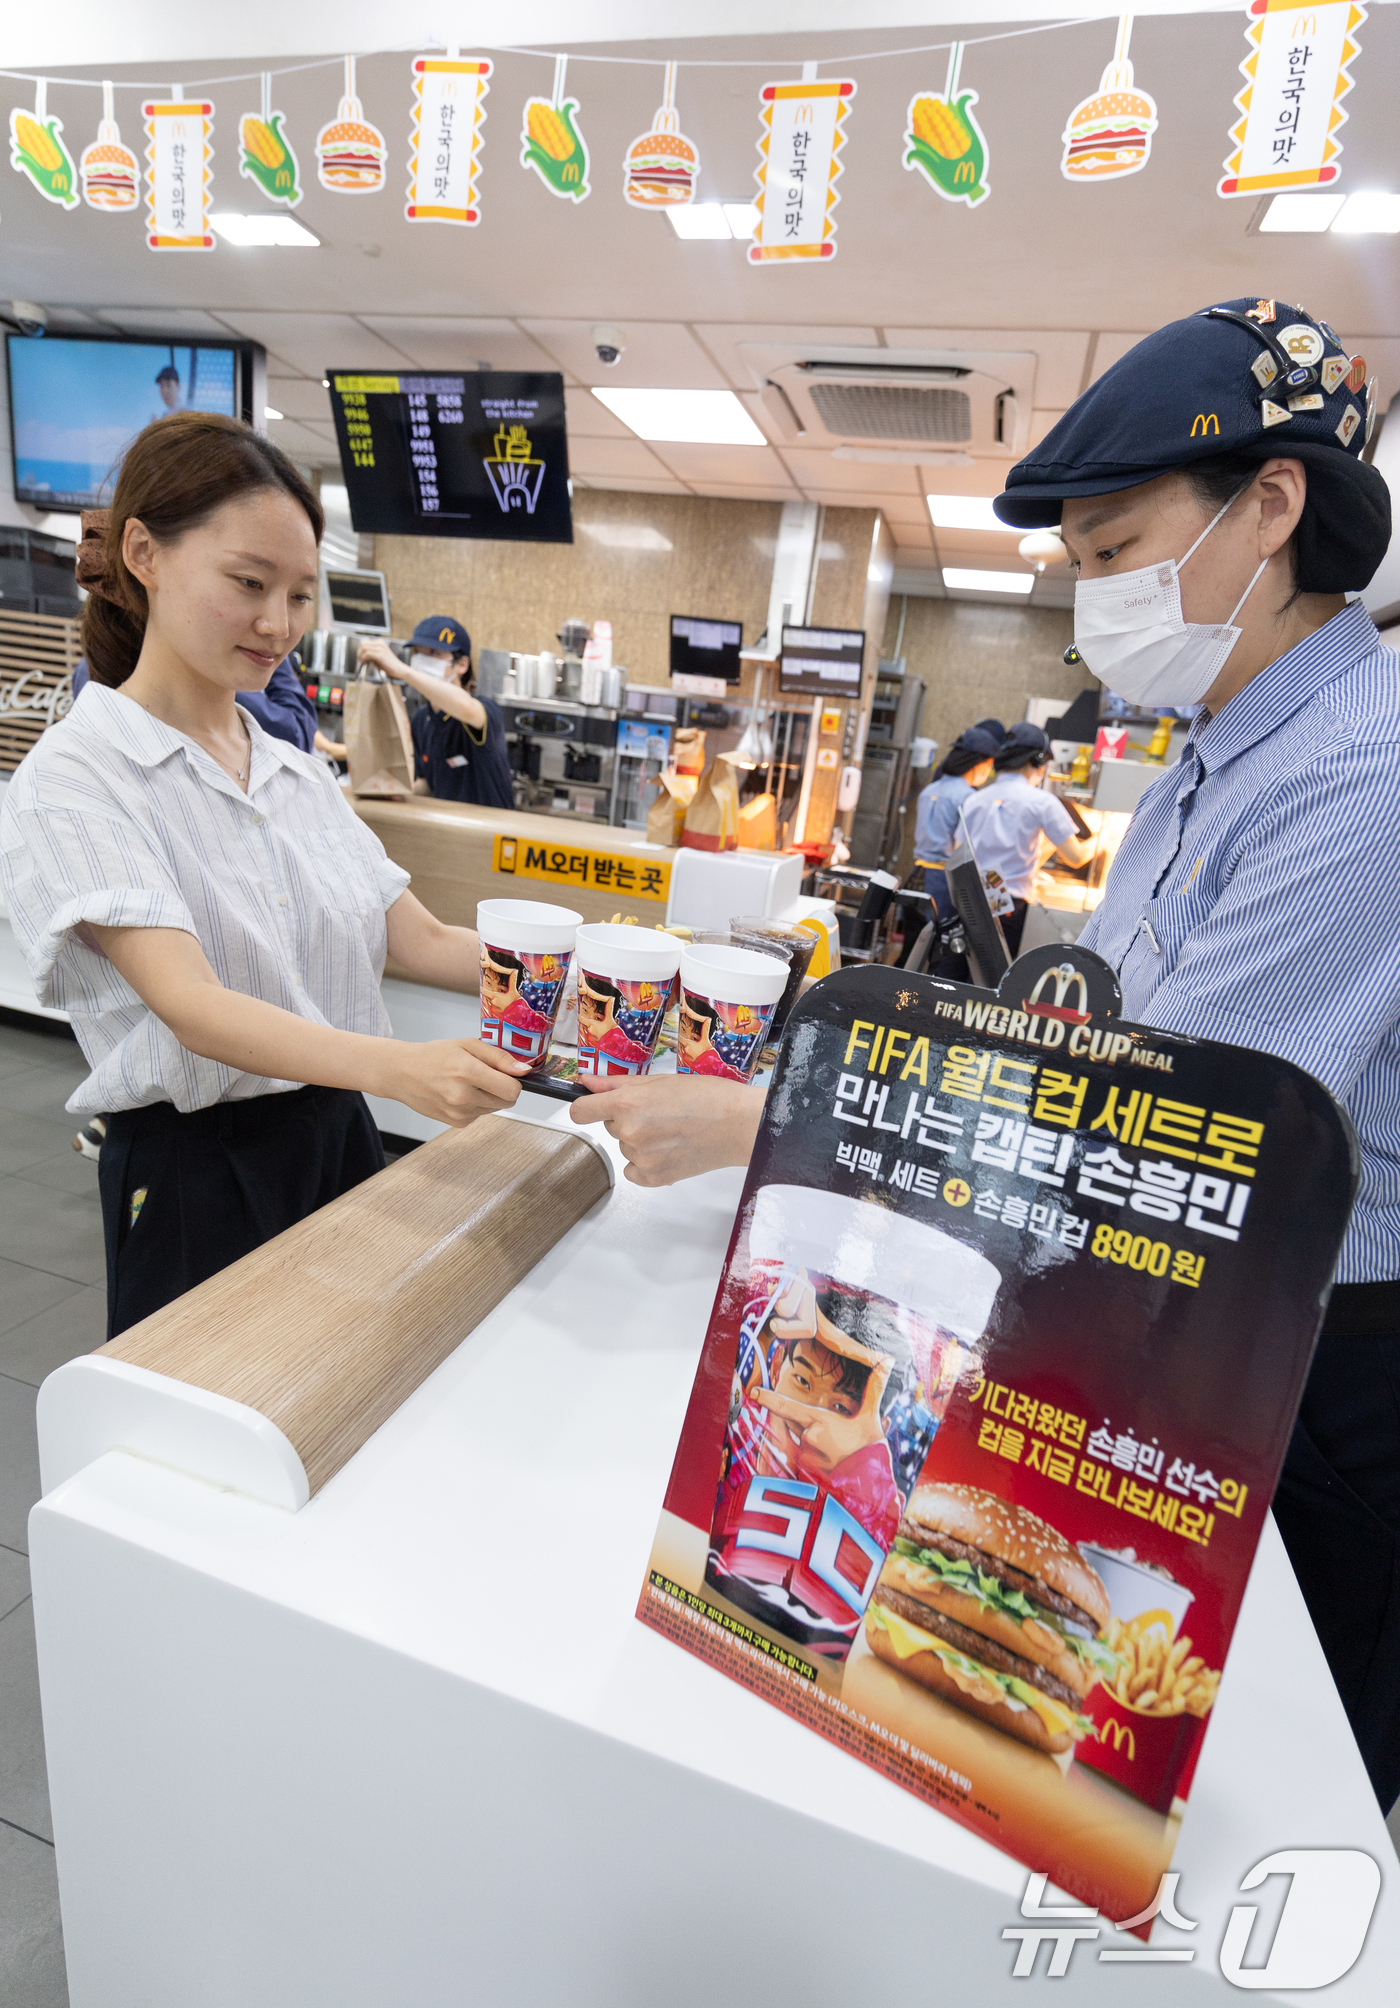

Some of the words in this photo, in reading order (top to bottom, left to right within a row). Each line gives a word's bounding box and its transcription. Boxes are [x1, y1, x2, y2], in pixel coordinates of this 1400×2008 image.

[485, 408, 501, 418] the
[502, 409, 534, 418] kitchen
[525, 847, 588, 881] M오더
[594, 858, 637, 889] 받는
[640, 867, 663, 894] 곳
[934, 1000, 963, 1022] FIFA
[963, 999, 1066, 1050] WORLD
[1068, 1024, 1131, 1065] CUP
[1131, 1047, 1174, 1073] MEAL
[843, 1019, 930, 1087] FIFA
[939, 1045, 1090, 1129] 월드컵
[1090, 1085, 1265, 1178] 세트로
[832, 1072, 965, 1154] 만나는
[971, 1111, 1076, 1188] 캡틴
[1076, 1145, 1252, 1242] 손흥민
[888, 1159, 941, 1199] 세트
[968, 1376, 1087, 1450] 기다려왔던
[1088, 1424, 1165, 1482] 손흥민
[1165, 1456, 1249, 1519] 선수의
[977, 1416, 1025, 1464] 컵을
[1025, 1437, 1076, 1486] 지금
[1075, 1458, 1215, 1547] 만나보세요!
[664, 1579, 686, 1602] 상품은
[687, 1593, 706, 1614] 1인당
[706, 1604, 723, 1625] 최대
[723, 1614, 753, 1643] 3개까지
[752, 1632, 770, 1653] 구매
[770, 1643, 814, 1679] 가능합니다.
[734, 1635, 790, 1680] 맥드라이브에서
[790, 1670, 808, 1691] 구매
[809, 1682, 826, 1702] 가능
[869, 1720, 898, 1748] M오더
[910, 1743, 947, 1778] 딜리버리
